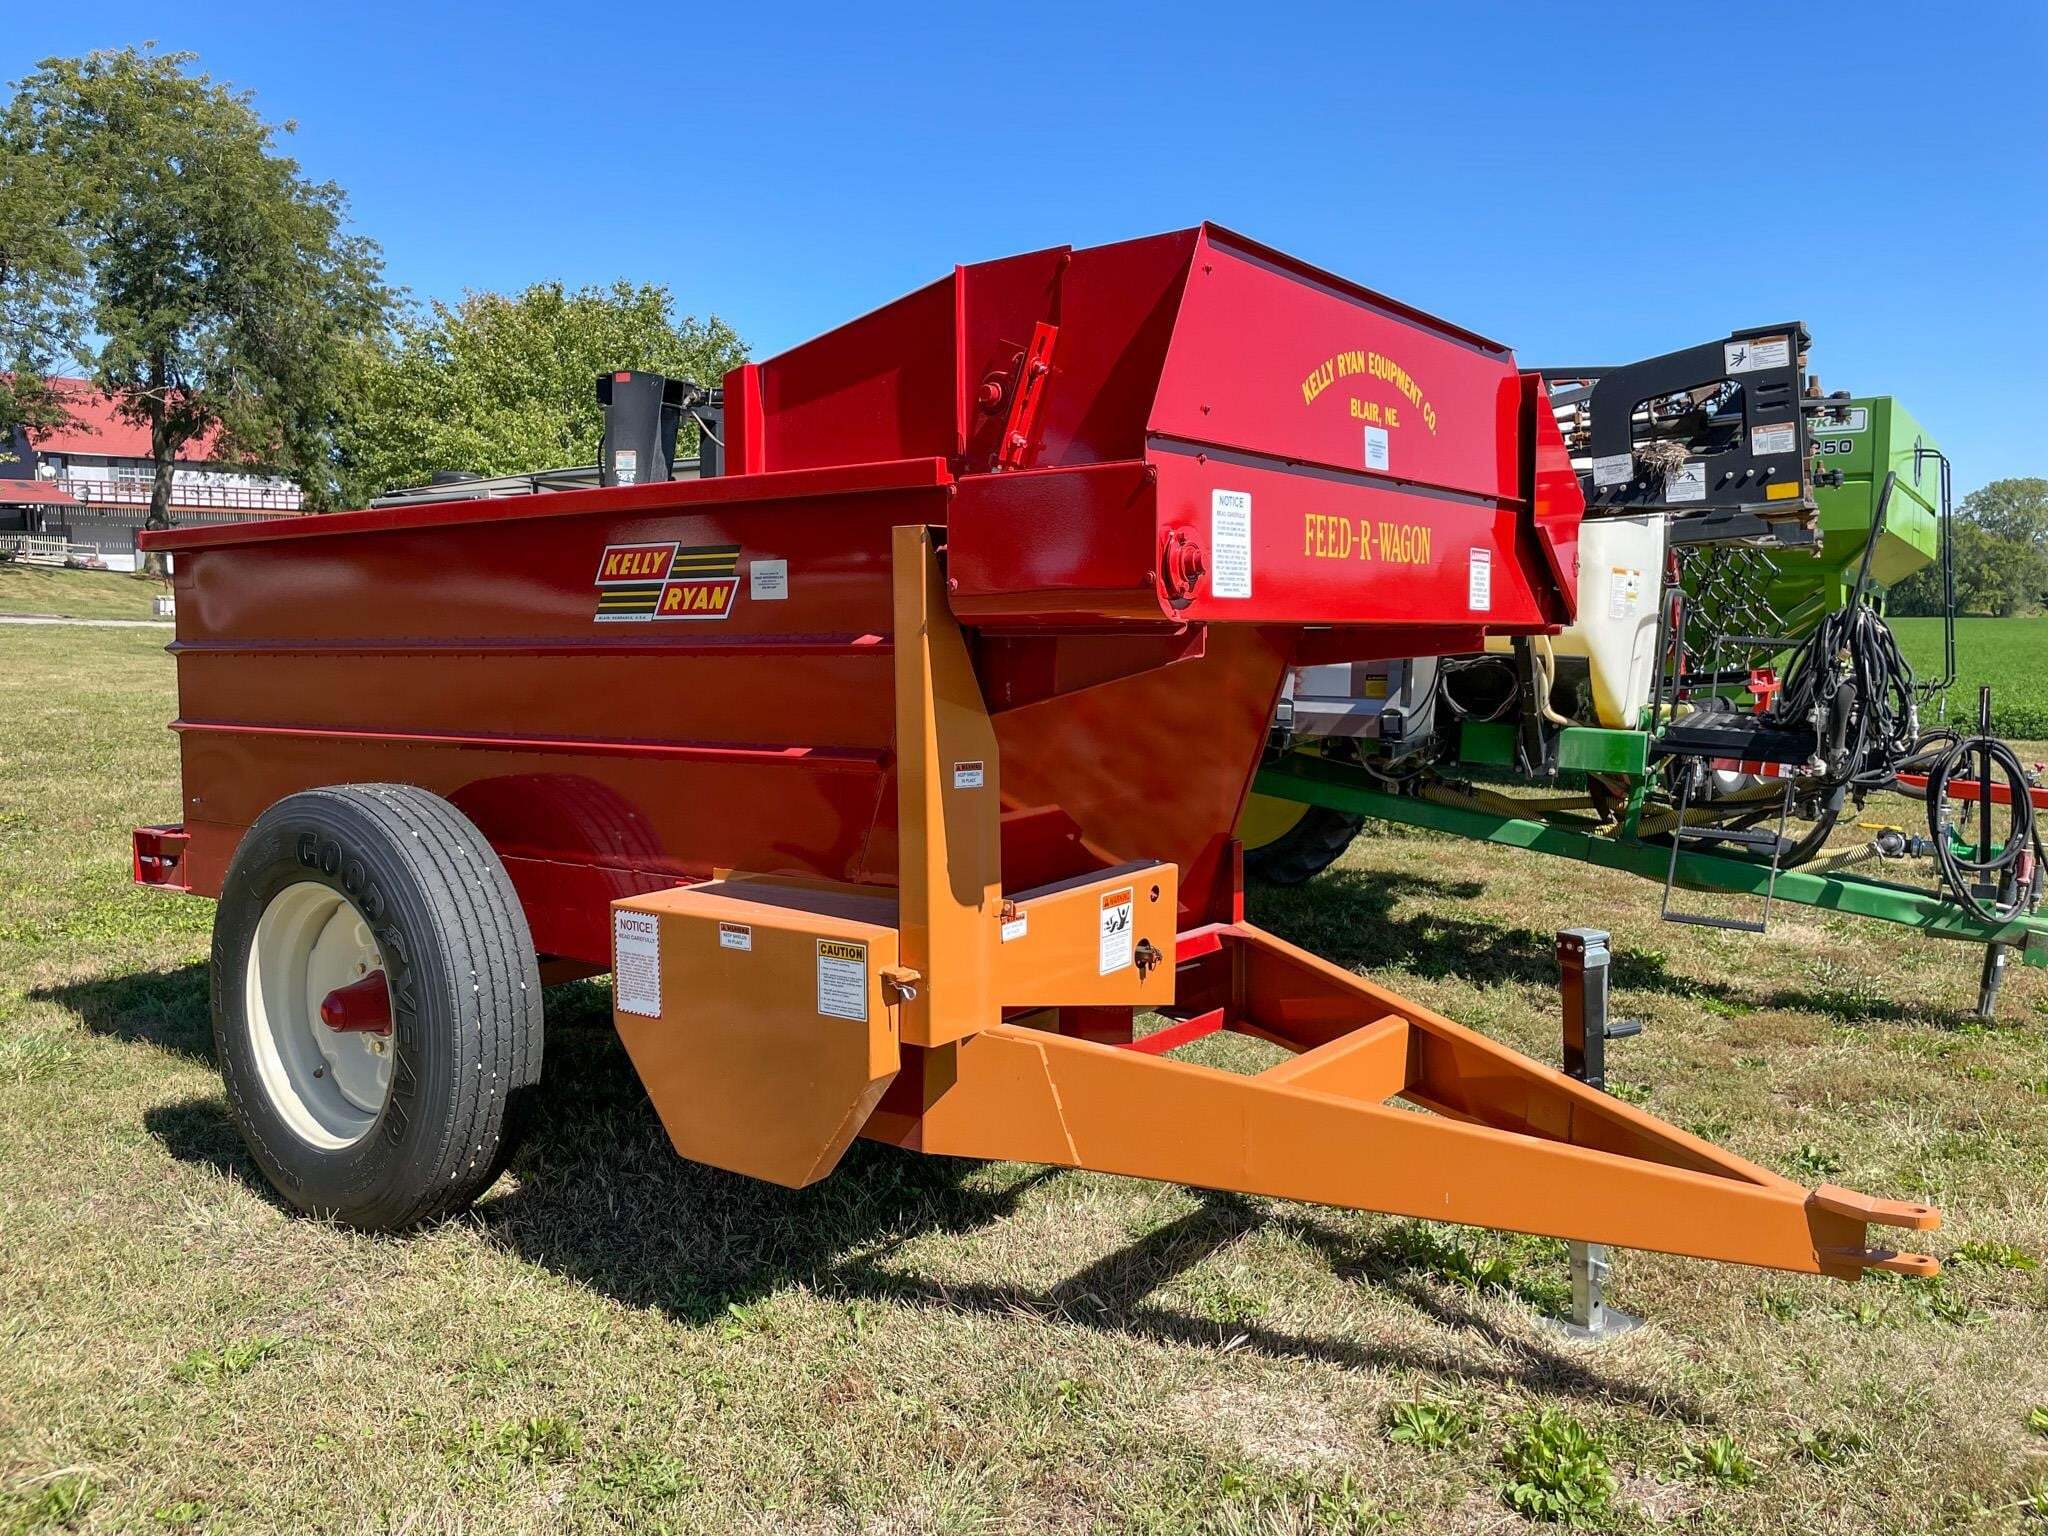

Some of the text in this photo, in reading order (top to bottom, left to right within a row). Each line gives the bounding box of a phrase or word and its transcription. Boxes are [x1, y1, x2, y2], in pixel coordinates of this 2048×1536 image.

[1301, 350, 1438, 436] KELLY RYAN EQUIPMENT CO.
[1350, 397, 1401, 428] BLAIR, NE.
[1219, 495, 1245, 508] NOTICE
[1303, 512, 1433, 565] FEED-R-WAGON
[604, 550, 669, 576] KELLY
[662, 586, 730, 611] RYAN
[620, 919, 654, 934] NOTICE!
[820, 943, 863, 960] CAUTION
